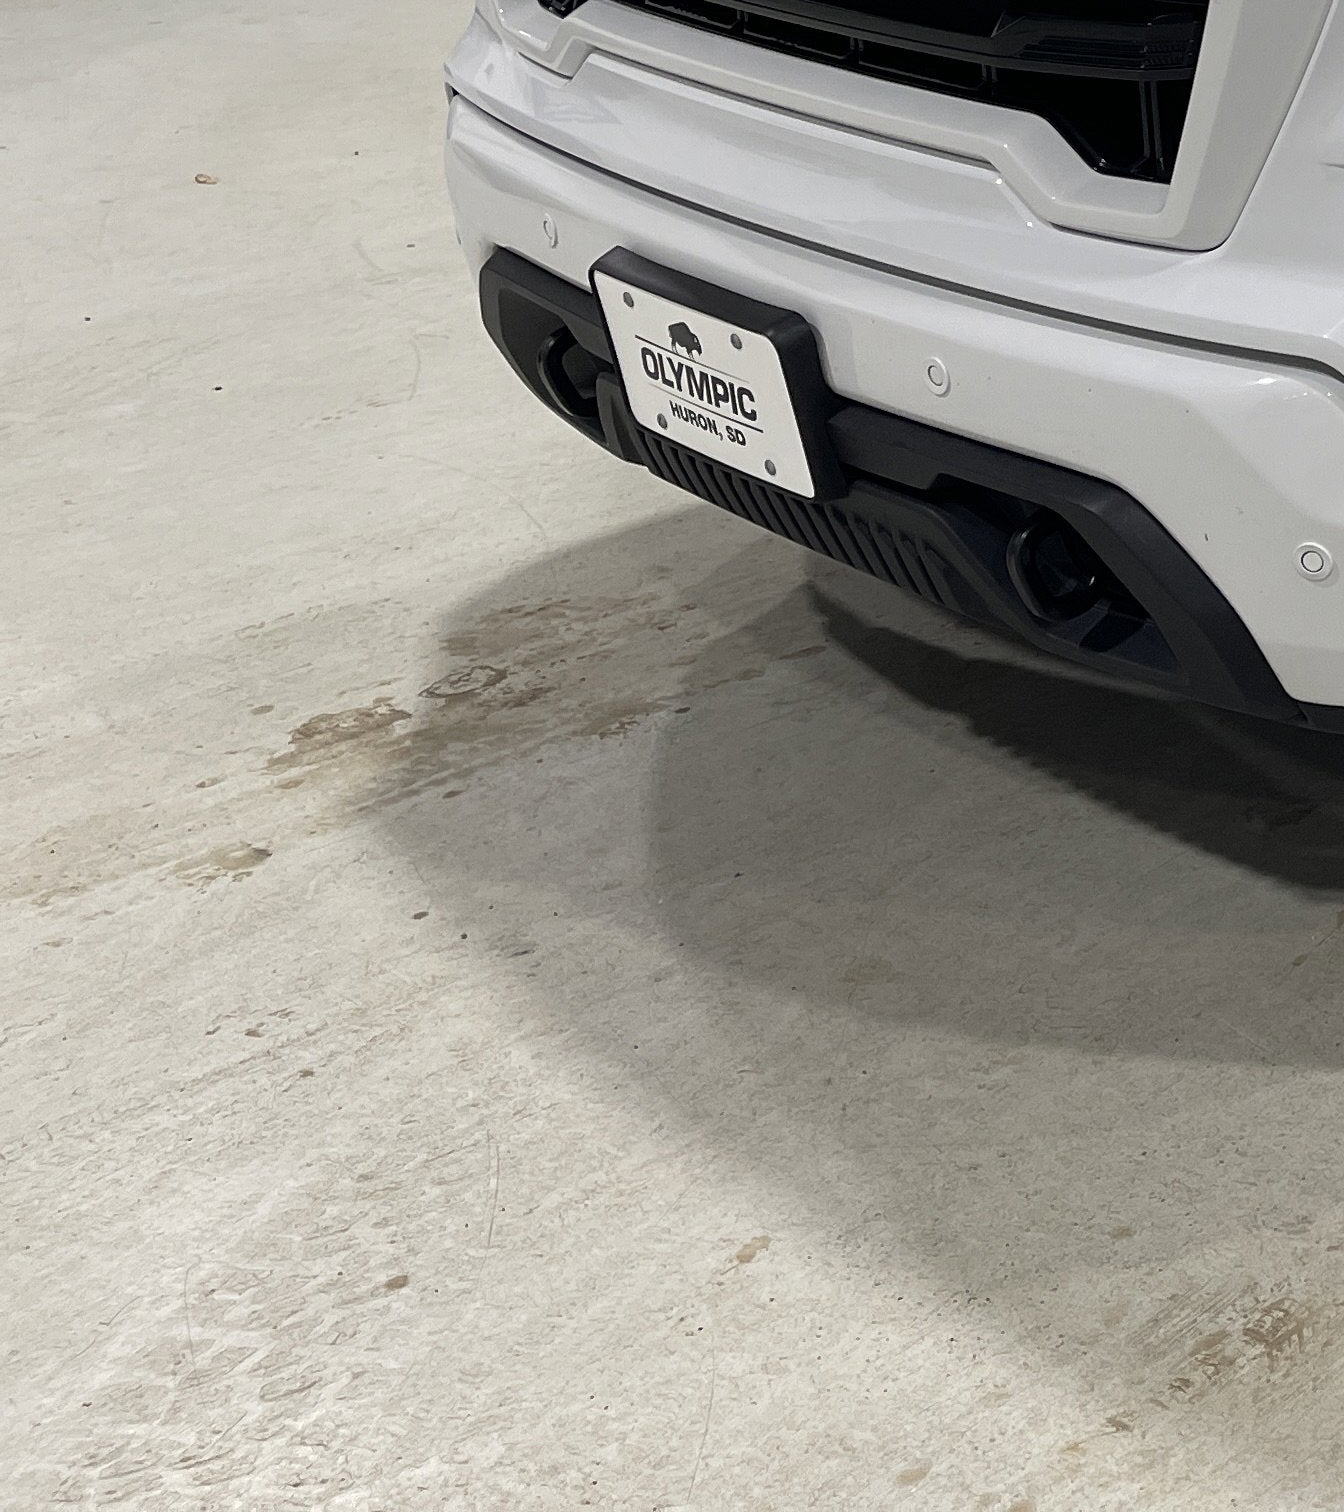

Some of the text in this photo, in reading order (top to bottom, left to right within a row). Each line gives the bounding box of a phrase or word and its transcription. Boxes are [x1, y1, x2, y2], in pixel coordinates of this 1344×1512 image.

[641, 346, 757, 422] OLYMPIC
[669, 399, 747, 447] HURON, SD
